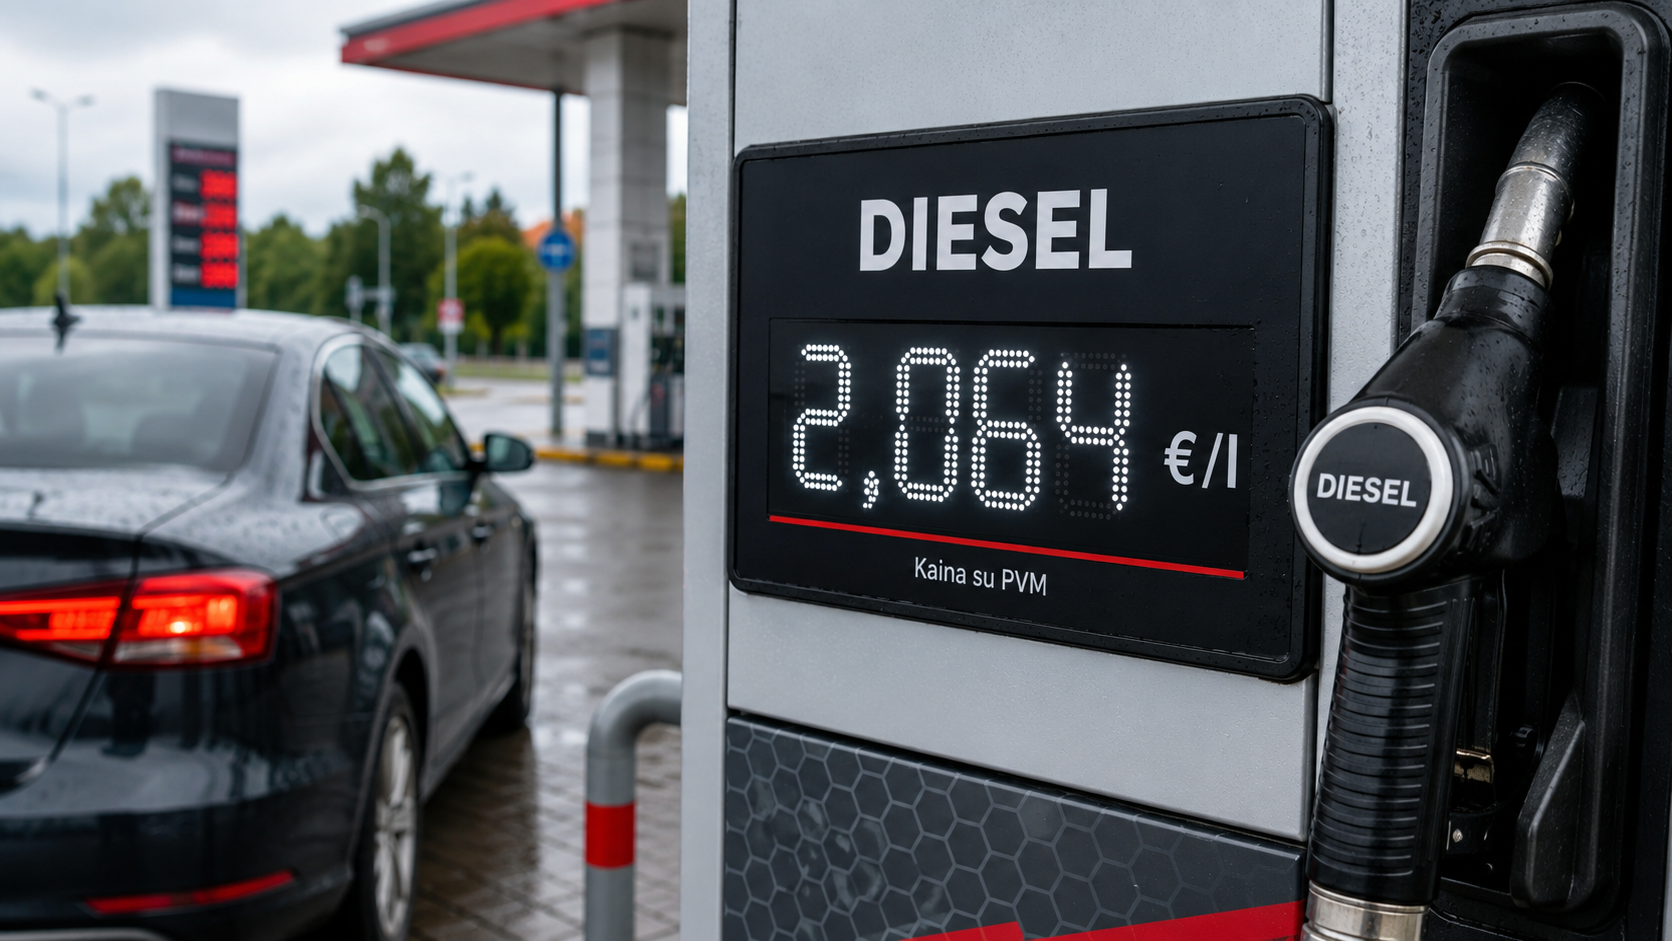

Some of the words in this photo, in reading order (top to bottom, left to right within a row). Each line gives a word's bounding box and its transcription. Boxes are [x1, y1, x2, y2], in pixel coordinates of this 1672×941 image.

[860, 189, 1132, 271] DIESEL
[793, 344, 1131, 511] 2,064
[1317, 473, 1417, 507] DIESEL
[915, 557, 966, 584] Kaina
[973, 570, 994, 588] su
[1002, 569, 1046, 596] PVM
